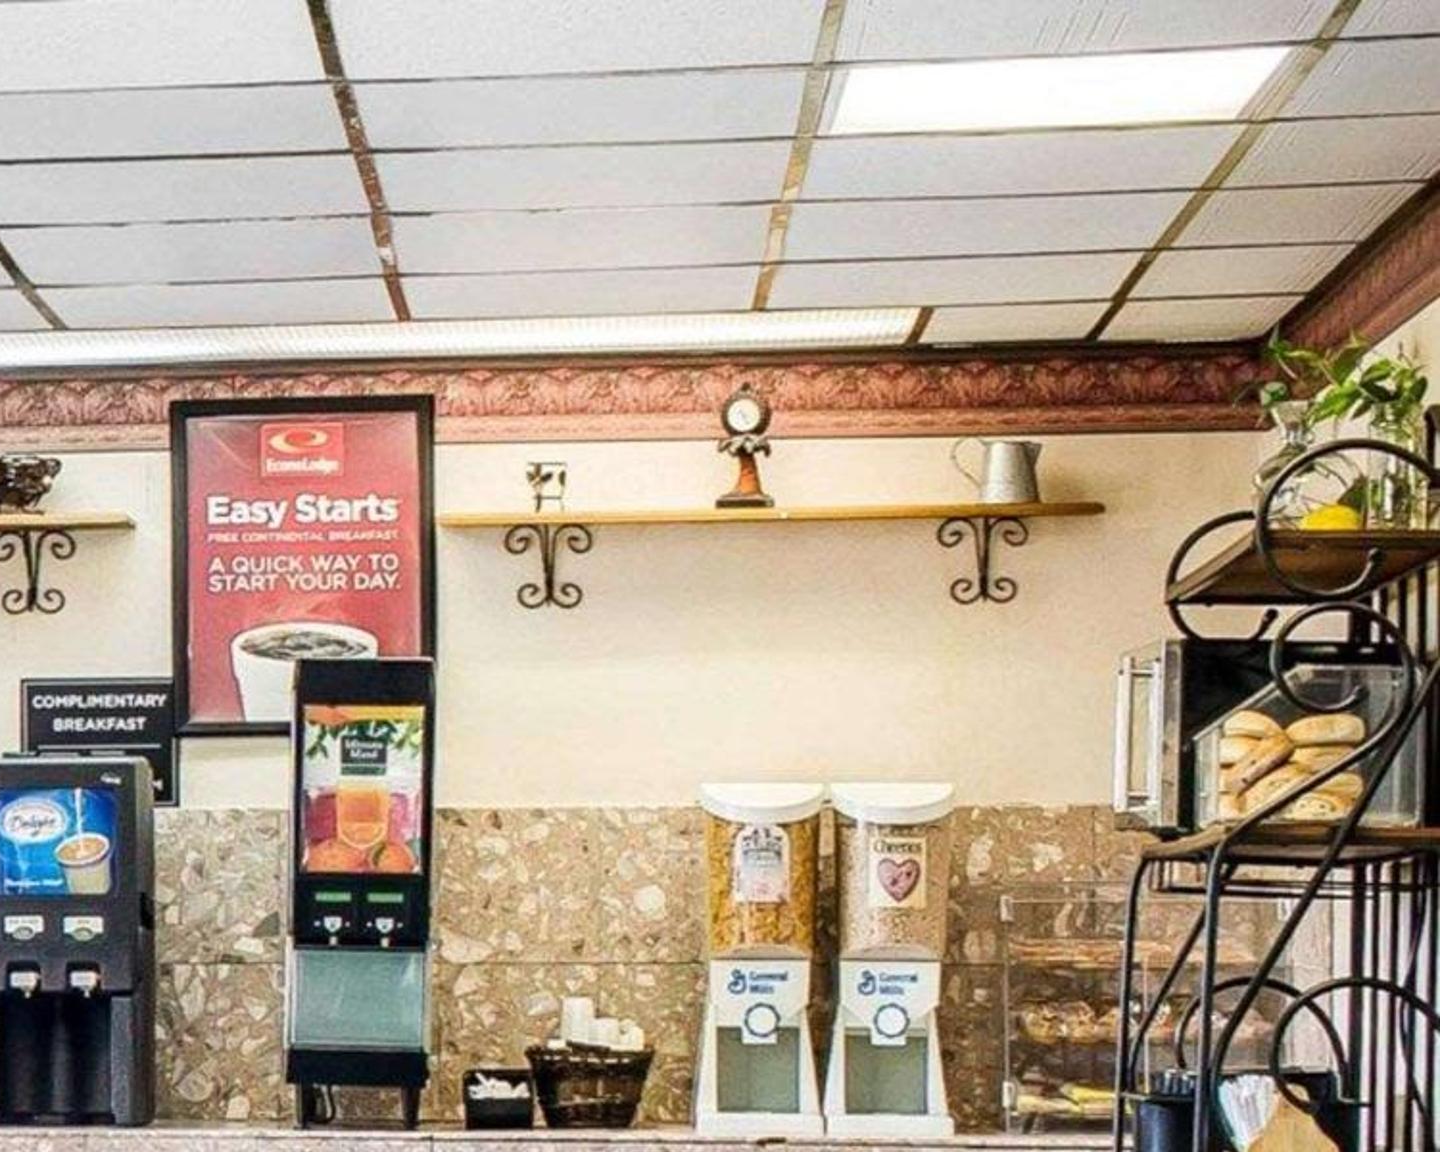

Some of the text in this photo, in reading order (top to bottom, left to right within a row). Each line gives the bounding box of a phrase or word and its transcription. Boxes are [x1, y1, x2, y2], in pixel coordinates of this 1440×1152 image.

[206, 493, 399, 528] Easy Starts
[327, 530, 399, 542] BREAKFAST
[208, 553, 400, 574] A QUICK WAY TO
[208, 573, 401, 592] START YOUR DAY.
[31, 693, 168, 709] COMPLIMENTARY
[53, 716, 147, 732] BREAKFAST
